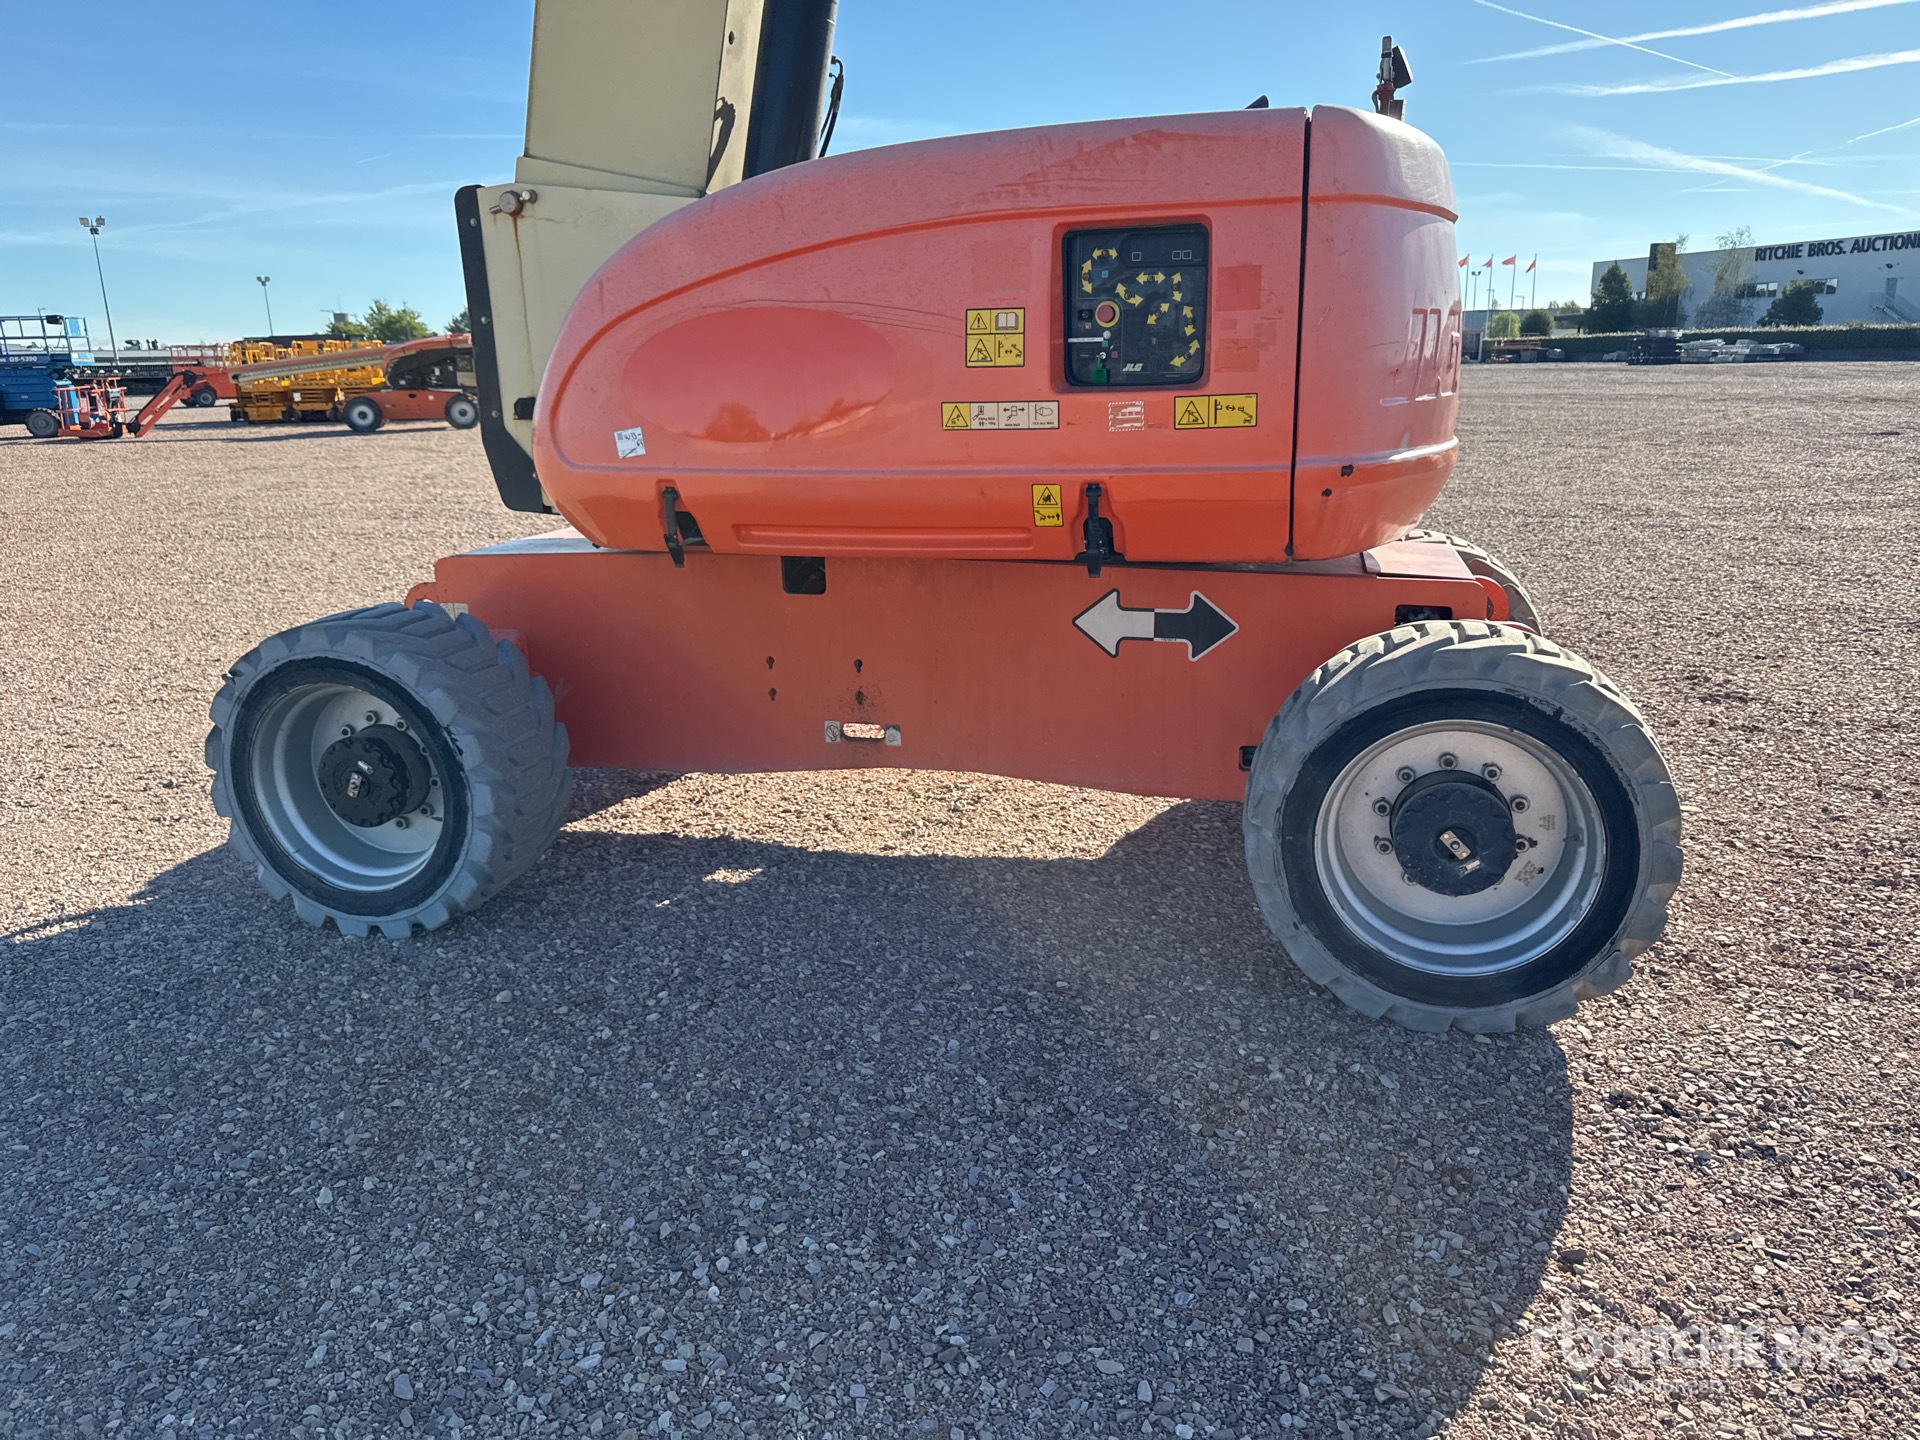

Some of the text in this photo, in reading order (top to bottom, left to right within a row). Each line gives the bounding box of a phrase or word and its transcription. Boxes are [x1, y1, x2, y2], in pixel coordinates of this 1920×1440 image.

[1755, 244, 1803, 261] RITCHIE
[1807, 240, 1846, 257] BROS.
[1122, 362, 1144, 372] JLG
